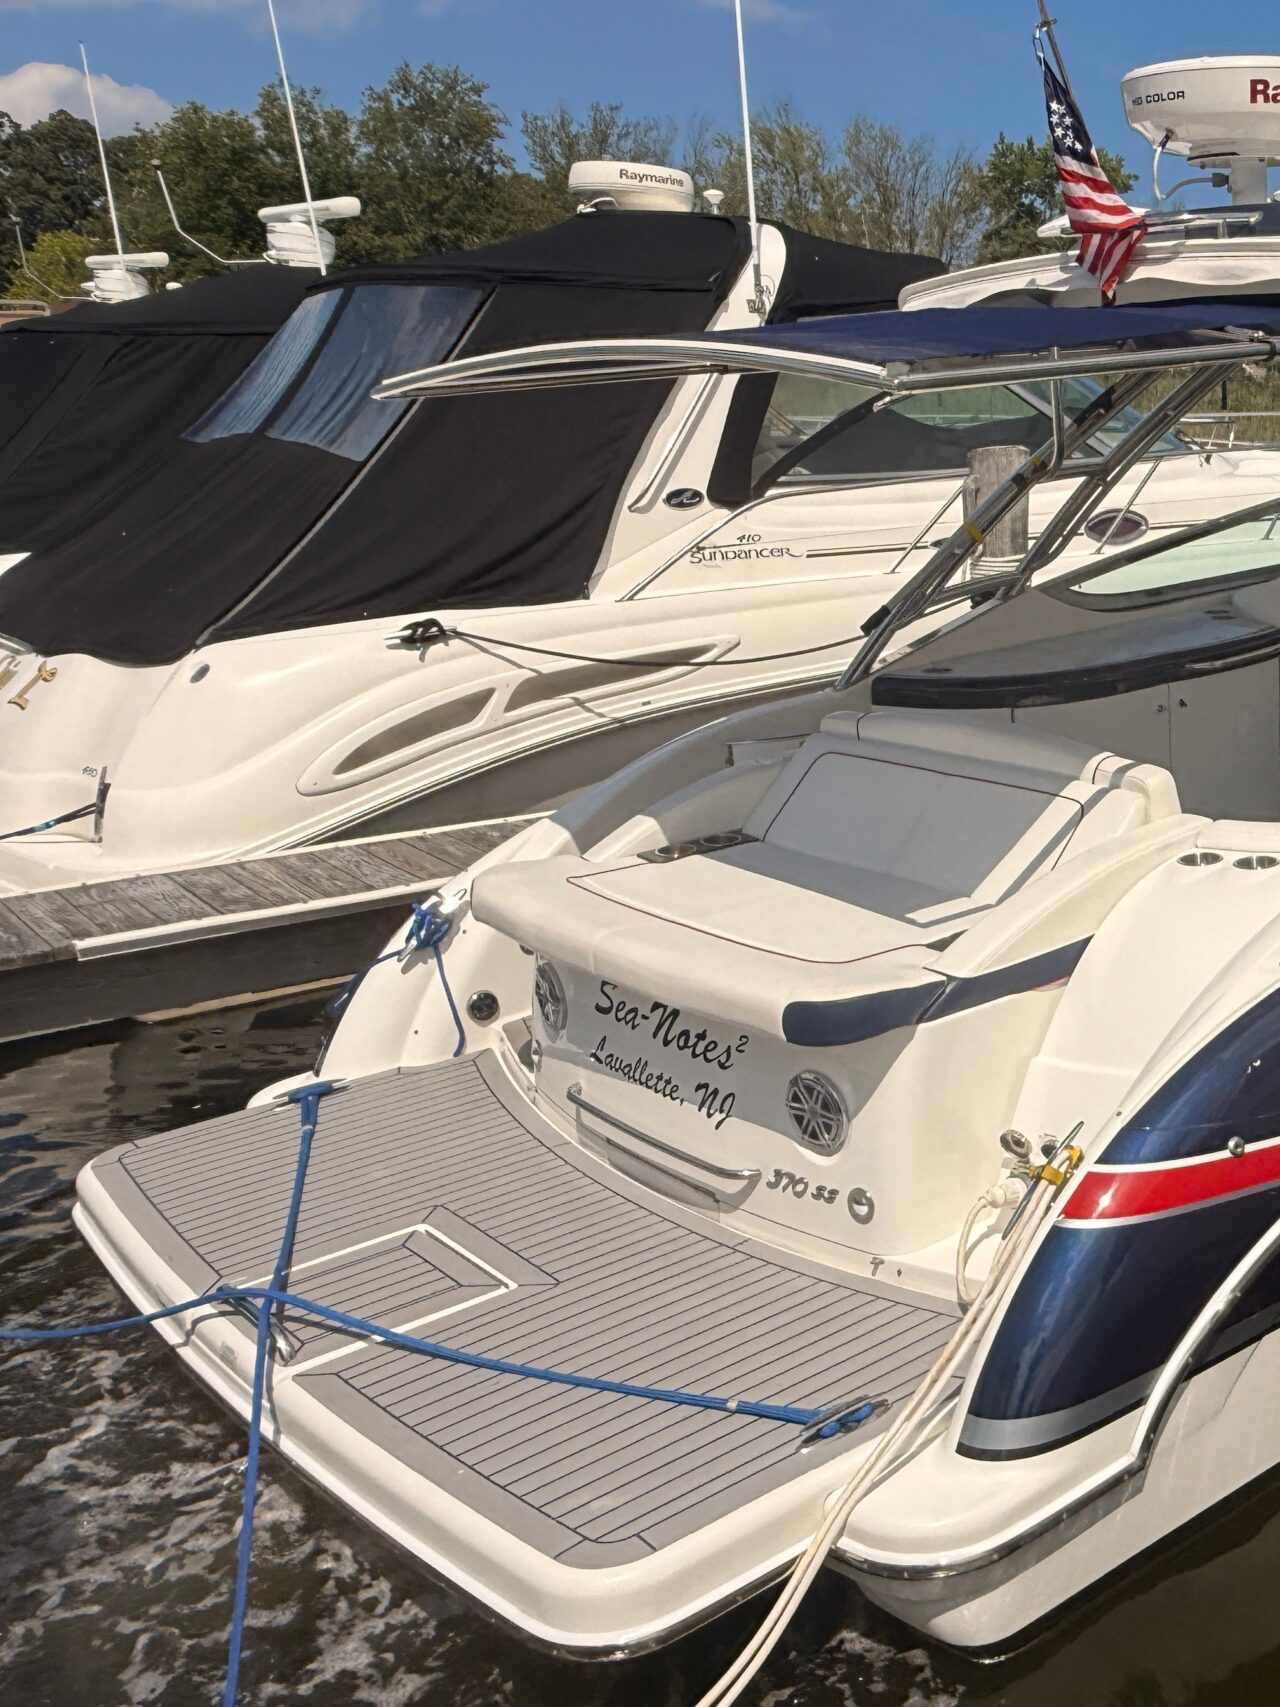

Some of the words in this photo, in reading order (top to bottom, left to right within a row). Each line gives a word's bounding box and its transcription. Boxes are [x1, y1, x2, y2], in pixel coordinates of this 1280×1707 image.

[1145, 90, 1186, 104] COLOR
[619, 168, 684, 187] Raymarine
[736, 533, 762, 543] 410
[589, 1036, 684, 1106] Lavallette,
[694, 1081, 736, 1131] NJ
